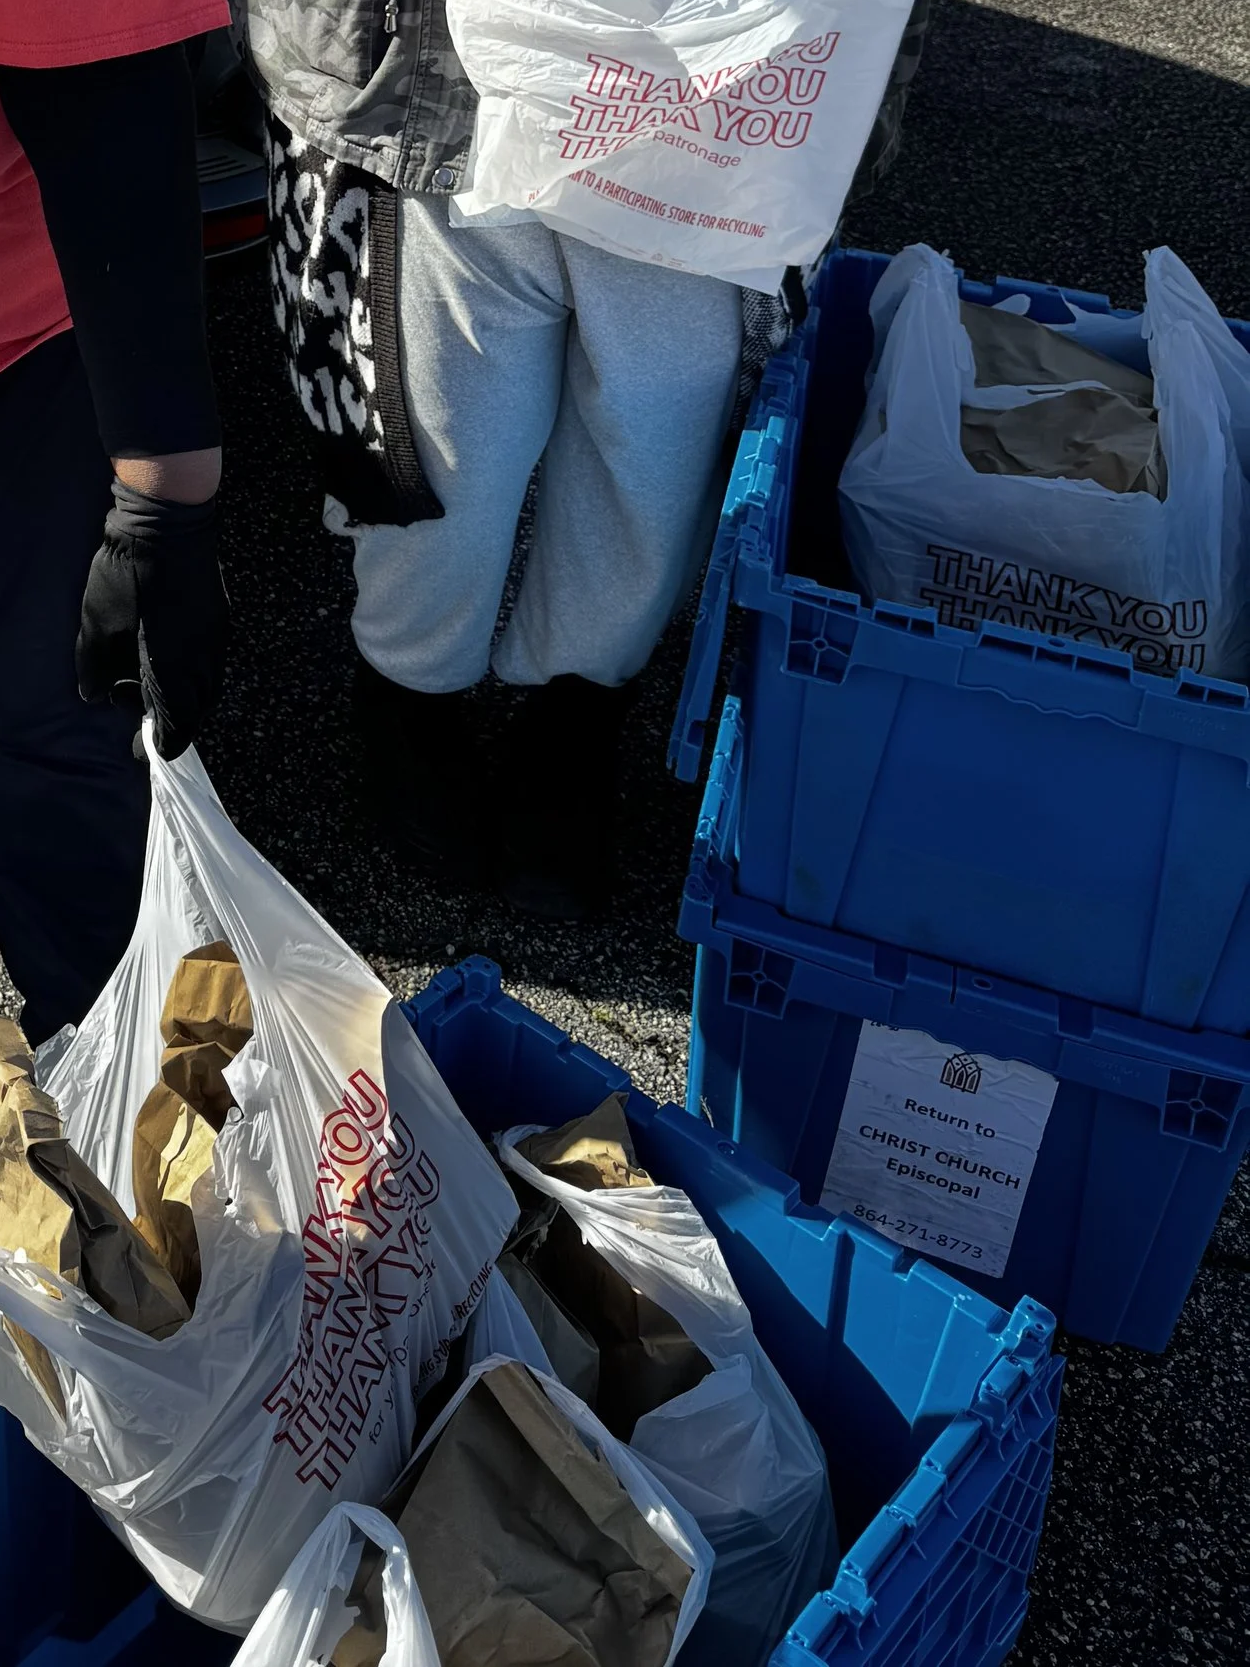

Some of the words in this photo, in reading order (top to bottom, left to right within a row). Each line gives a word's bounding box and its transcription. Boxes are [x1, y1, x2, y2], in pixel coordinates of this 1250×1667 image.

[712, 99, 813, 148] YOU
[652, 131, 741, 168] patronage
[582, 171, 596, 188] TO
[602, 179, 667, 217] PARTICIPATING
[667, 205, 698, 226] STORE
[697, 213, 717, 230] FOR
[716, 217, 767, 239] RECYCLING
[926, 543, 1100, 622] THANK
[1102, 586, 1208, 639] YOU
[904, 1098, 969, 1130] Return
[975, 1122, 996, 1138] to
[859, 1124, 931, 1158] CHRIST
[934, 1150, 1021, 1190] CHURCH
[885, 1157, 981, 1200] Episcopal
[853, 1203, 983, 1260] 864-271-8773
[368, 1409, 386, 1445] for
